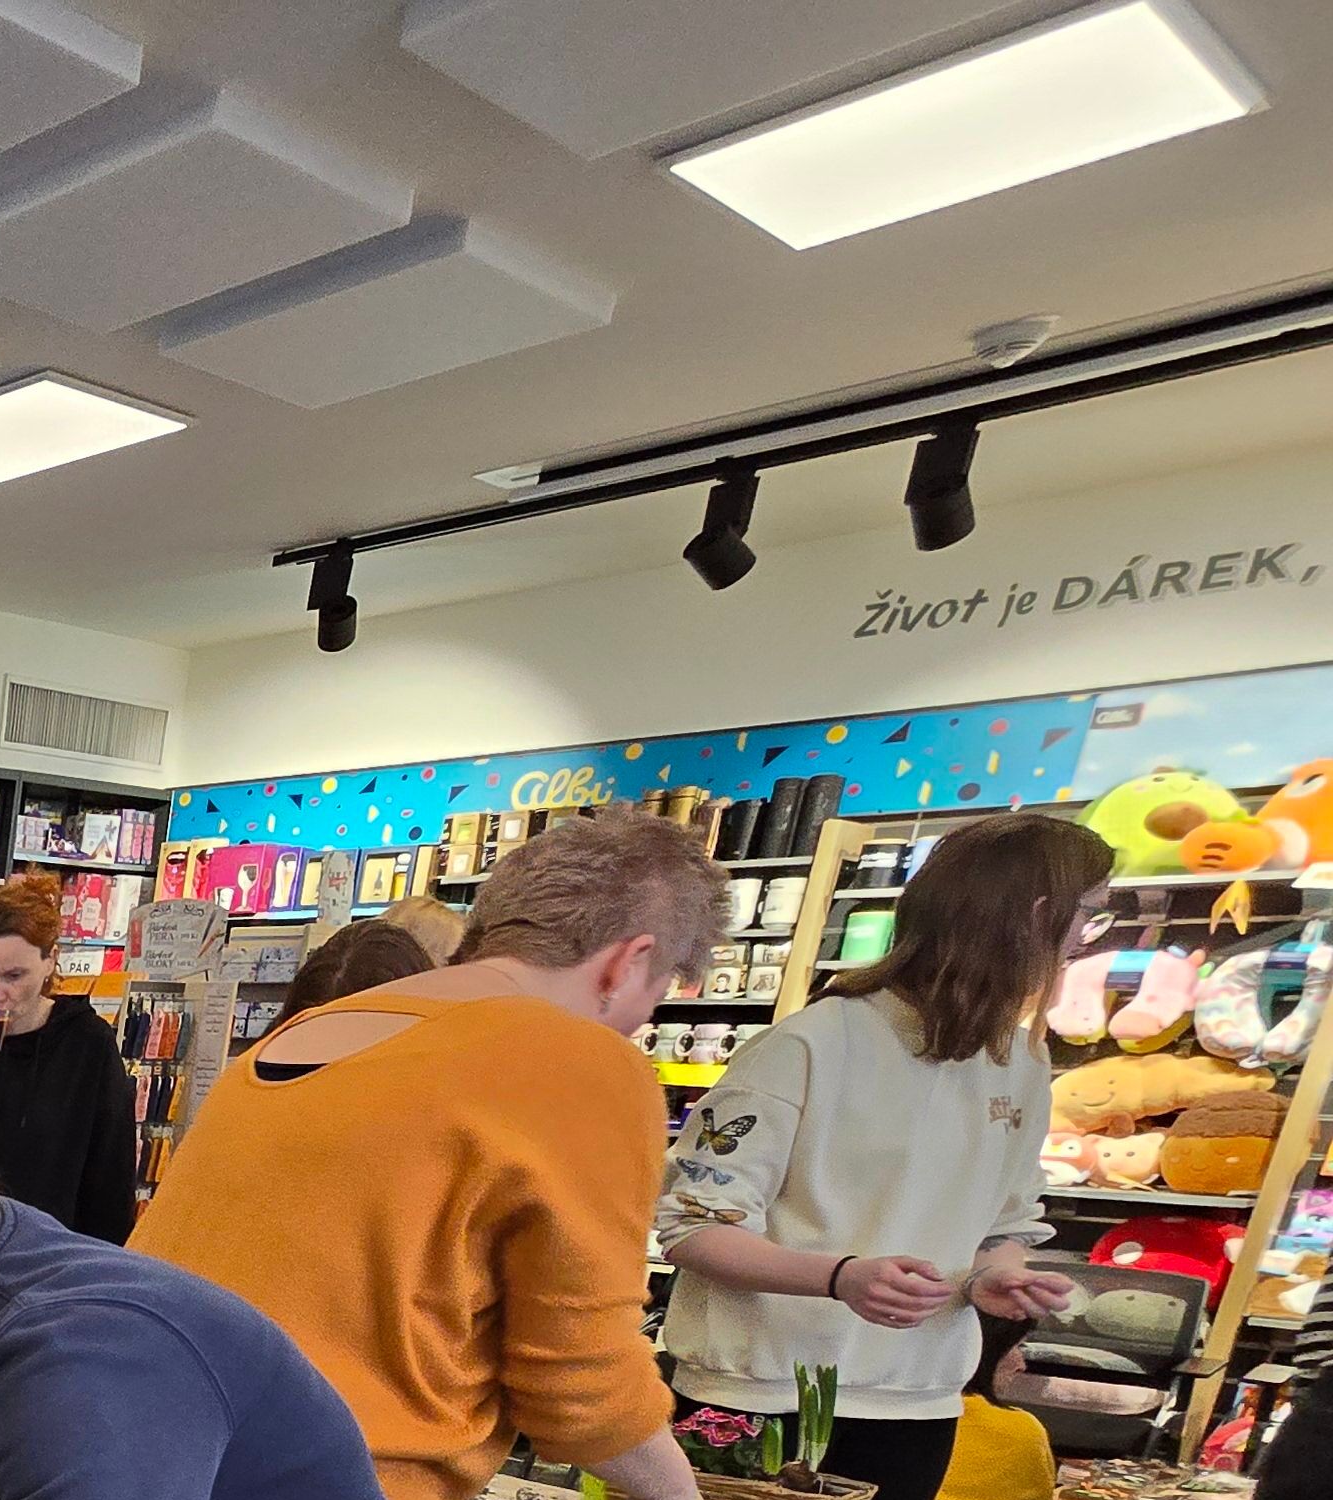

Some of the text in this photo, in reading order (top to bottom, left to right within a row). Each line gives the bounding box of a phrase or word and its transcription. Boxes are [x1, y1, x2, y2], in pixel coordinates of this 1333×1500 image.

[853, 542, 1326, 639] Život je DÁREK,
[69, 960, 90, 973] PÁR
